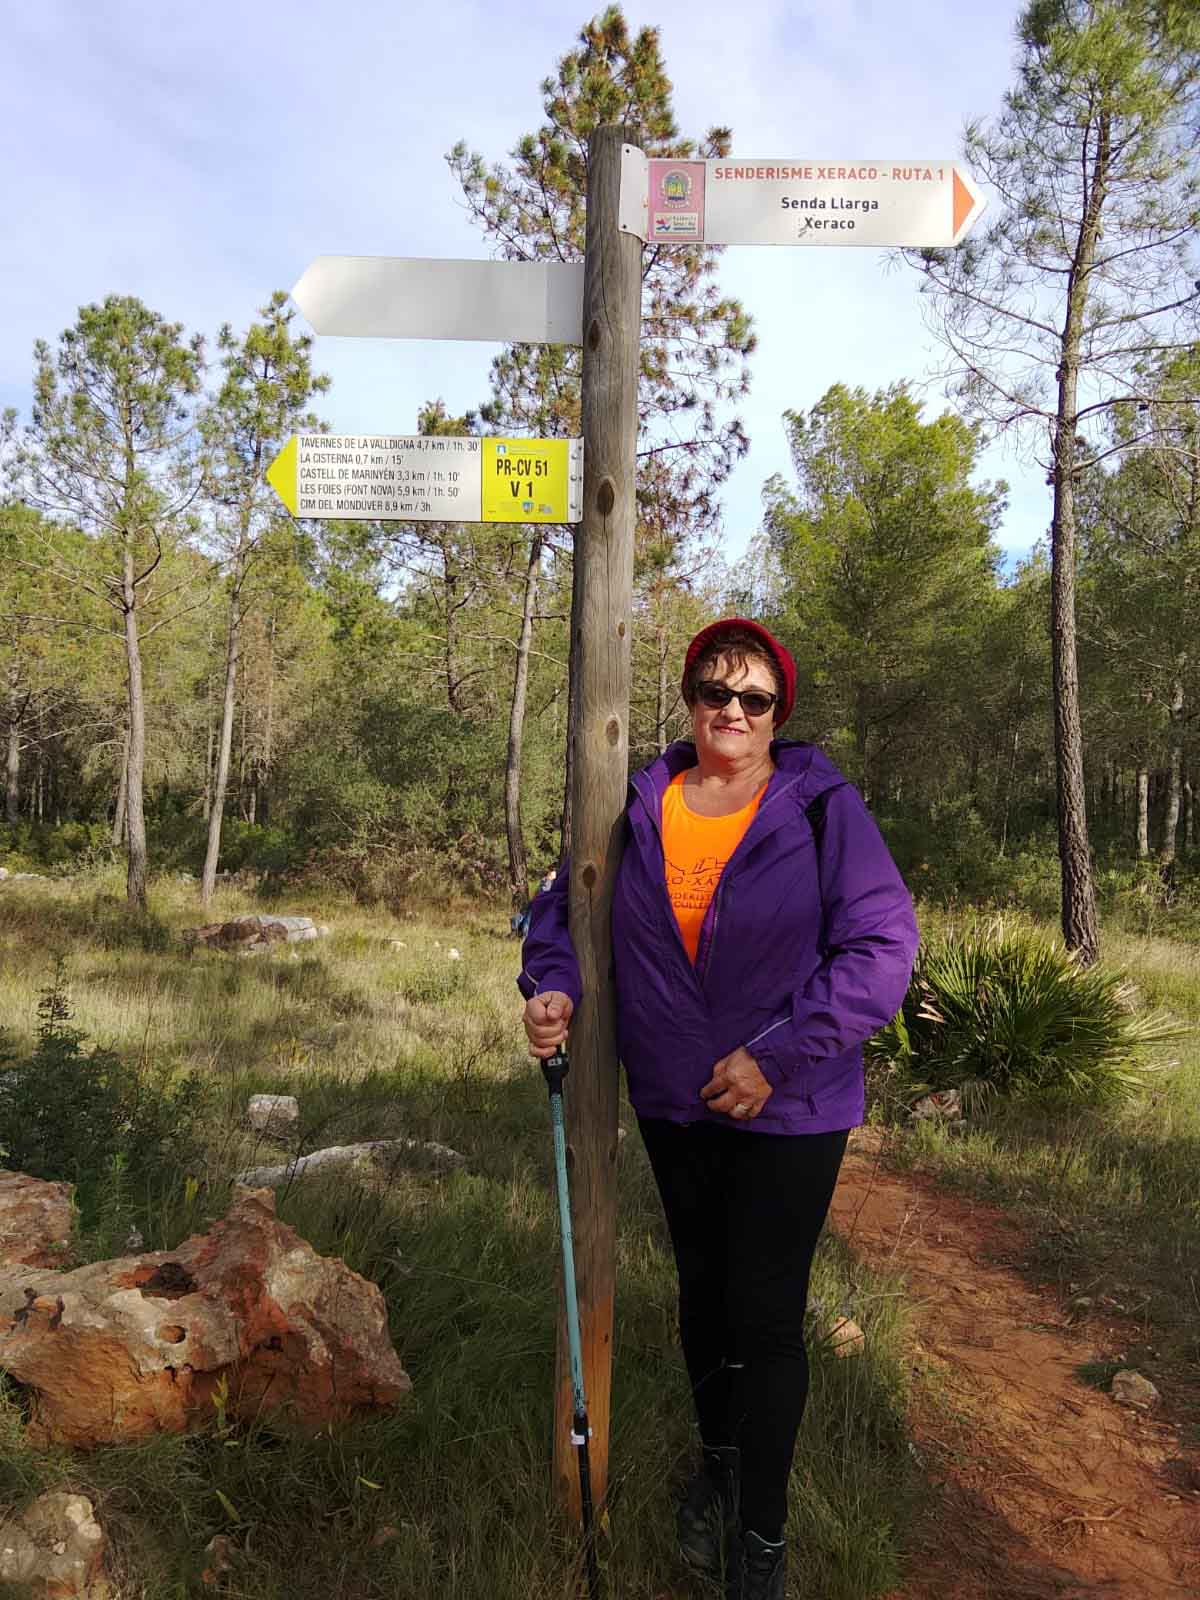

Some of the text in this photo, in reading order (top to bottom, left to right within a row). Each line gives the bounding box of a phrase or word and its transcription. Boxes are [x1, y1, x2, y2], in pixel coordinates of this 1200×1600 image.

[714, 167, 812, 180] SENDERISME
[817, 168, 877, 180] XERACO
[892, 168, 932, 181] RUTA
[937, 168, 944, 181] 1
[781, 197, 879, 212] Senda Llarga
[804, 217, 855, 229] Xeraco
[301, 437, 342, 449] TAVERNES
[344, 438, 356, 449] DE
[358, 438, 368, 449] LA
[369, 438, 415, 449] VALLDIGNA
[417, 439, 429, 452] 4,7
[432, 440, 445, 451] km
[300, 452, 311, 463] LA
[313, 453, 353, 464] CISTERNA
[371, 454, 384, 464] km
[300, 467, 336, 479] CASTELL
[338, 468, 349, 479] DE
[397, 470, 410, 482] 3,3
[412, 470, 425, 481] km
[496, 458, 548, 477] PR-CV 51
[300, 483, 316, 494] LES
[318, 484, 342, 494] FOIES
[344, 484, 368, 496] (FONT
[371, 485, 394, 497] NOVA)
[412, 486, 425, 496] km
[510, 481, 533, 498] V 1
[301, 498, 315, 509] CIM
[319, 499, 334, 509] DEL
[400, 501, 412, 512] km
